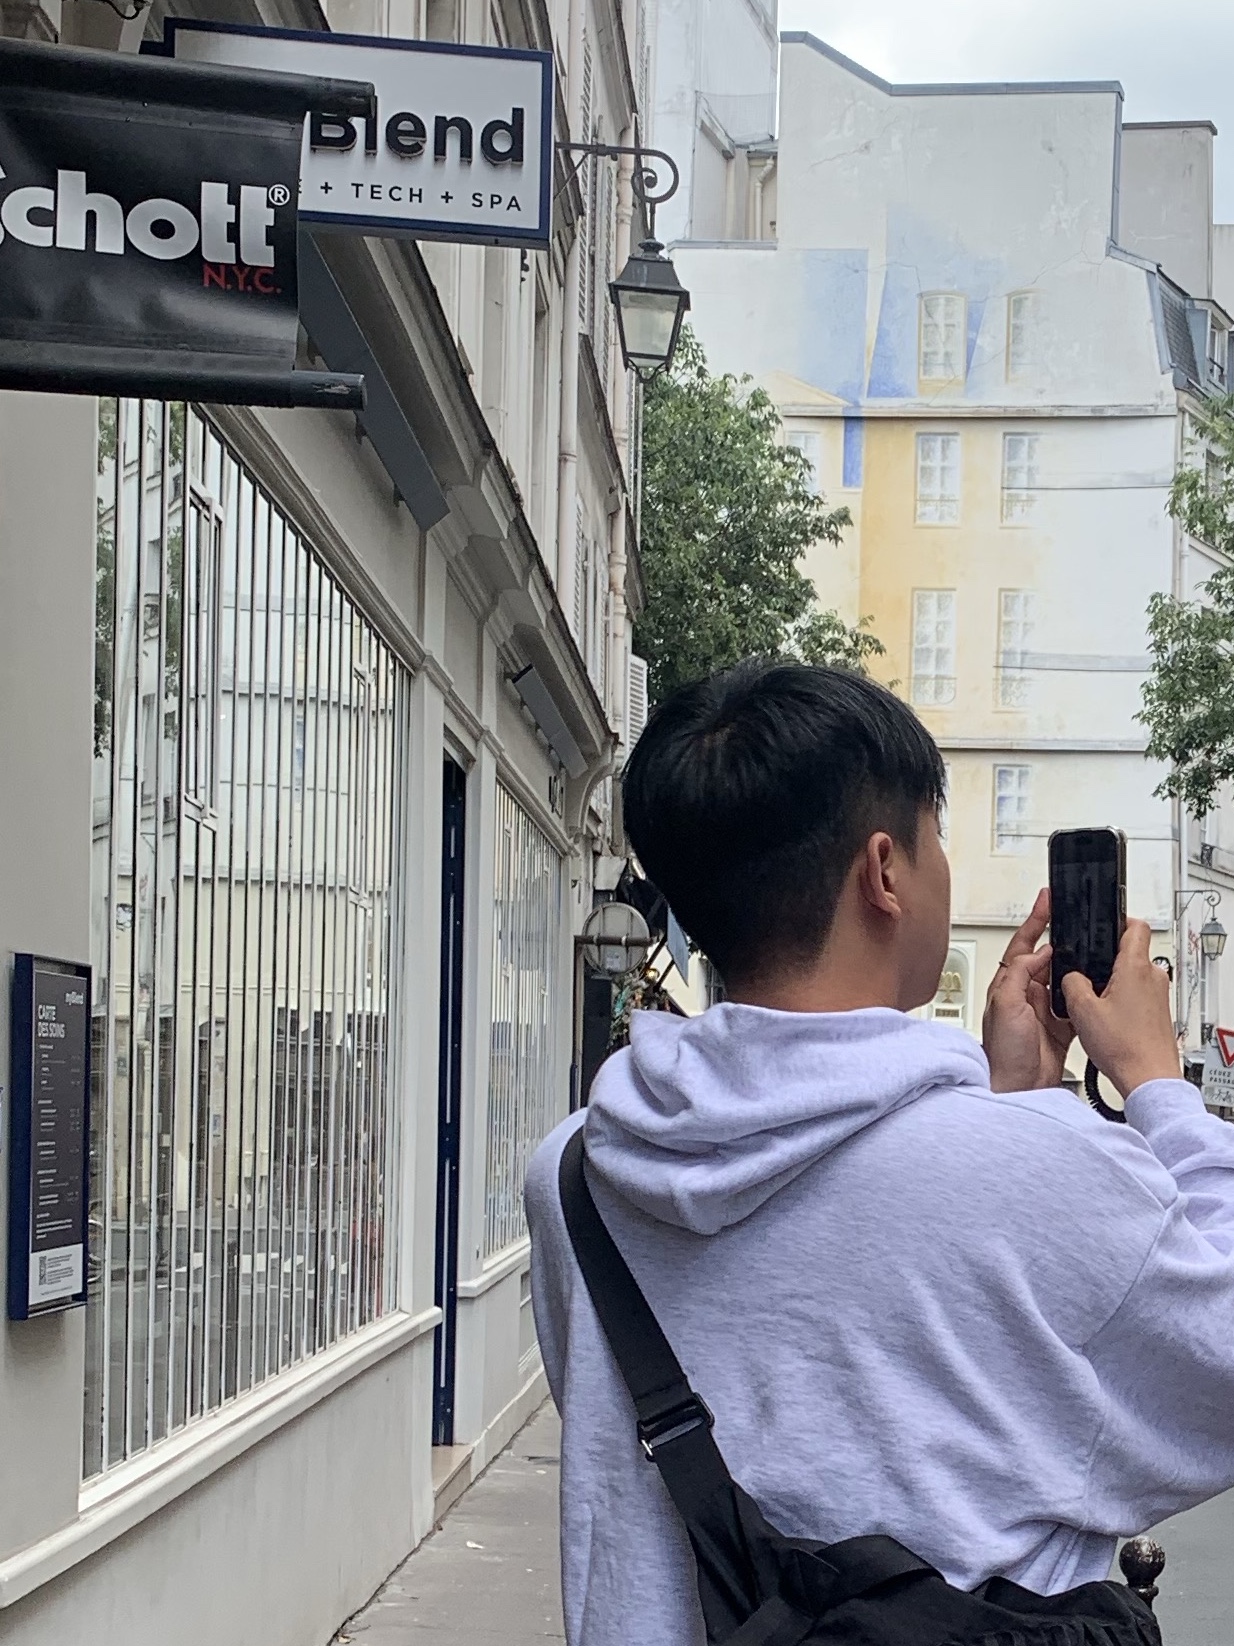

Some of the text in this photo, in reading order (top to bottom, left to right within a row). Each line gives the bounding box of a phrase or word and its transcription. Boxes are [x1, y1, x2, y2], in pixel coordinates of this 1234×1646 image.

[351, 182, 423, 203] TECH
[472, 192, 522, 212] SPA
[203, 263, 283, 294] N.Y.C.
[38, 1021, 49, 1037] DES
